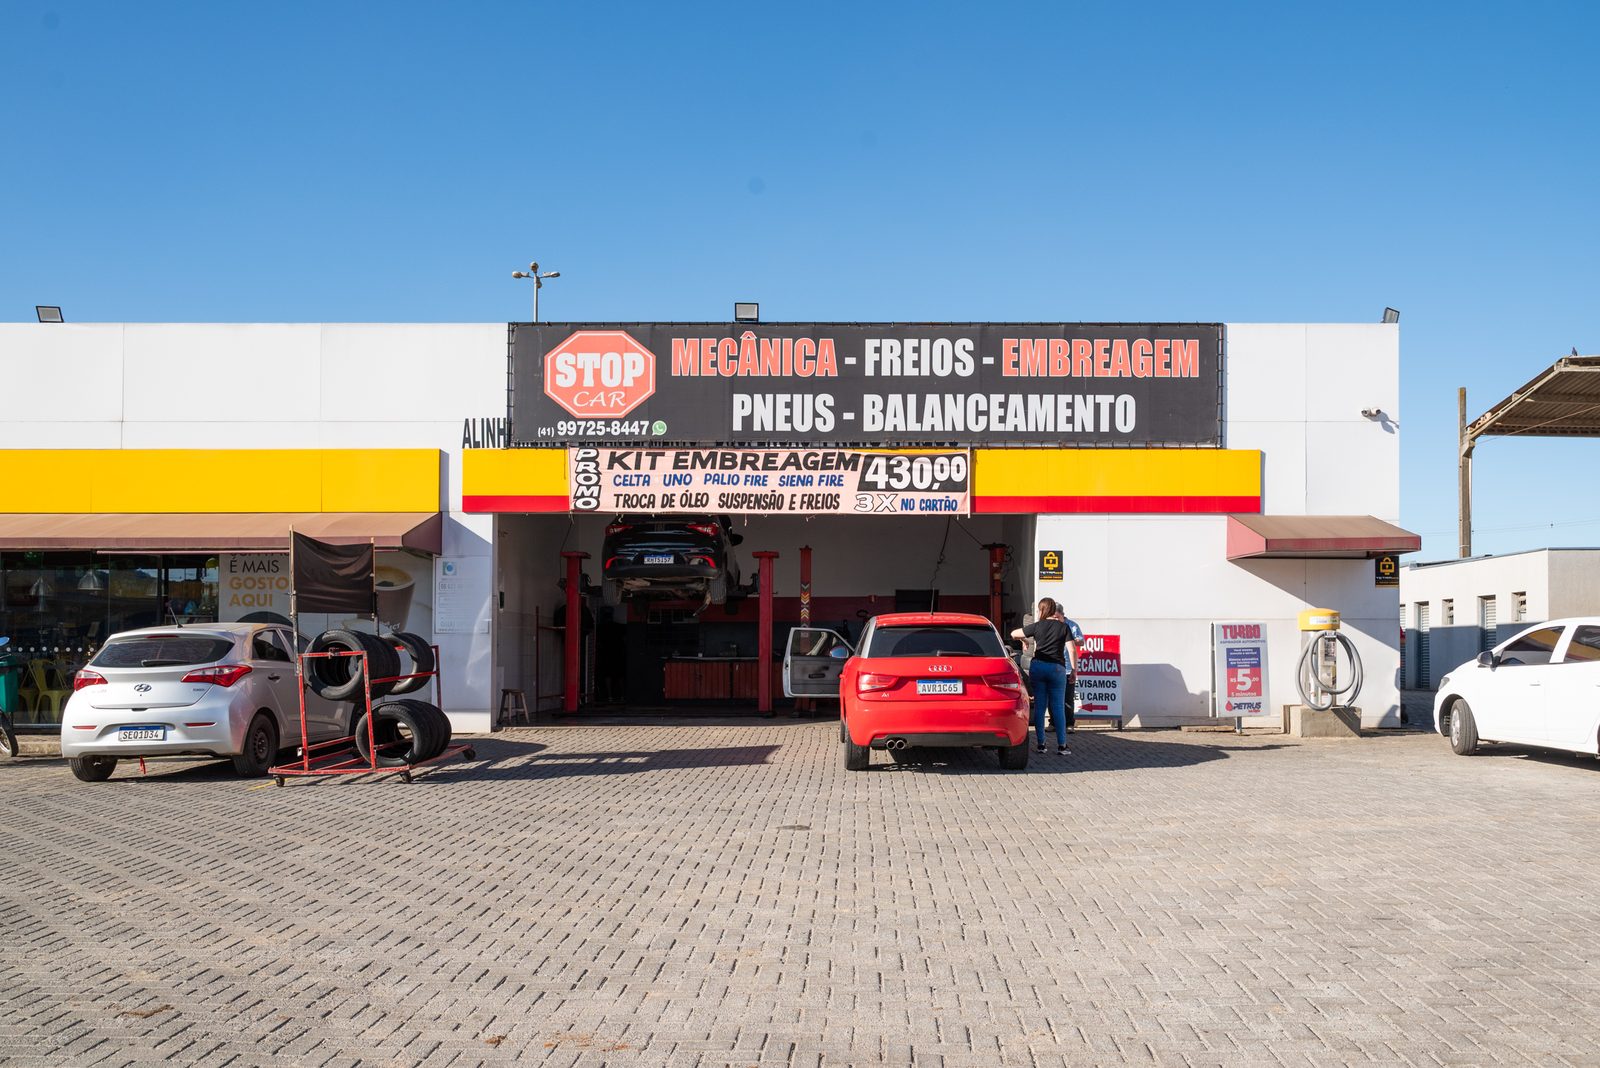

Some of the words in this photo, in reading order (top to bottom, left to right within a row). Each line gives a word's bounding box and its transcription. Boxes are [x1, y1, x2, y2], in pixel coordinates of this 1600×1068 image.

[671, 331, 838, 377] MECÂNICA
[865, 338, 975, 377] FREIOS
[1002, 338, 1200, 378] EMBREAGEM
[556, 352, 645, 387] STOP
[573, 391, 627, 408] CAR
[732, 393, 836, 432] PNEUS
[863, 393, 1136, 433] BALANCEAMENTO
[462, 417, 507, 448] ALINH
[537, 427, 555, 437] (41)
[557, 420, 649, 436] 99725-8447
[606, 451, 666, 471] KIT
[672, 451, 861, 472] EMBREAGEM
[575, 448, 602, 510] PROMO
[613, 474, 651, 487] CELTA
[663, 473, 693, 487] UNO
[703, 473, 740, 486] PALIO
[743, 474, 769, 487] FIRE
[778, 474, 814, 487] SIENA
[817, 474, 844, 487] FIRE
[865, 455, 967, 490] 430,00
[613, 493, 656, 508] TROCA
[660, 493, 676, 508] DE
[680, 489, 710, 508] ÓLEO
[717, 489, 785, 510] SUSPENSÃO
[788, 493, 797, 511] E
[799, 493, 840, 510] FREIOS
[854, 493, 898, 512] 3X
[900, 498, 915, 511] NO
[919, 496, 958, 511] CARTÃO
[230, 556, 238, 573] É
[242, 560, 280, 573] MAIS
[229, 576, 290, 590] GOSTO
[229, 593, 273, 607] AQUI
[1222, 624, 1261, 640] TURBO
[1080, 638, 1104, 652] AQUI
[1077, 655, 1118, 672] ECÂNICA
[922, 684, 958, 692] AVR1C65
[1075, 680, 1117, 688] EVISAMOS
[1074, 692, 1085, 701] EU
[1087, 692, 1116, 701] CARRO
[1233, 702, 1262, 710] PETRUS
